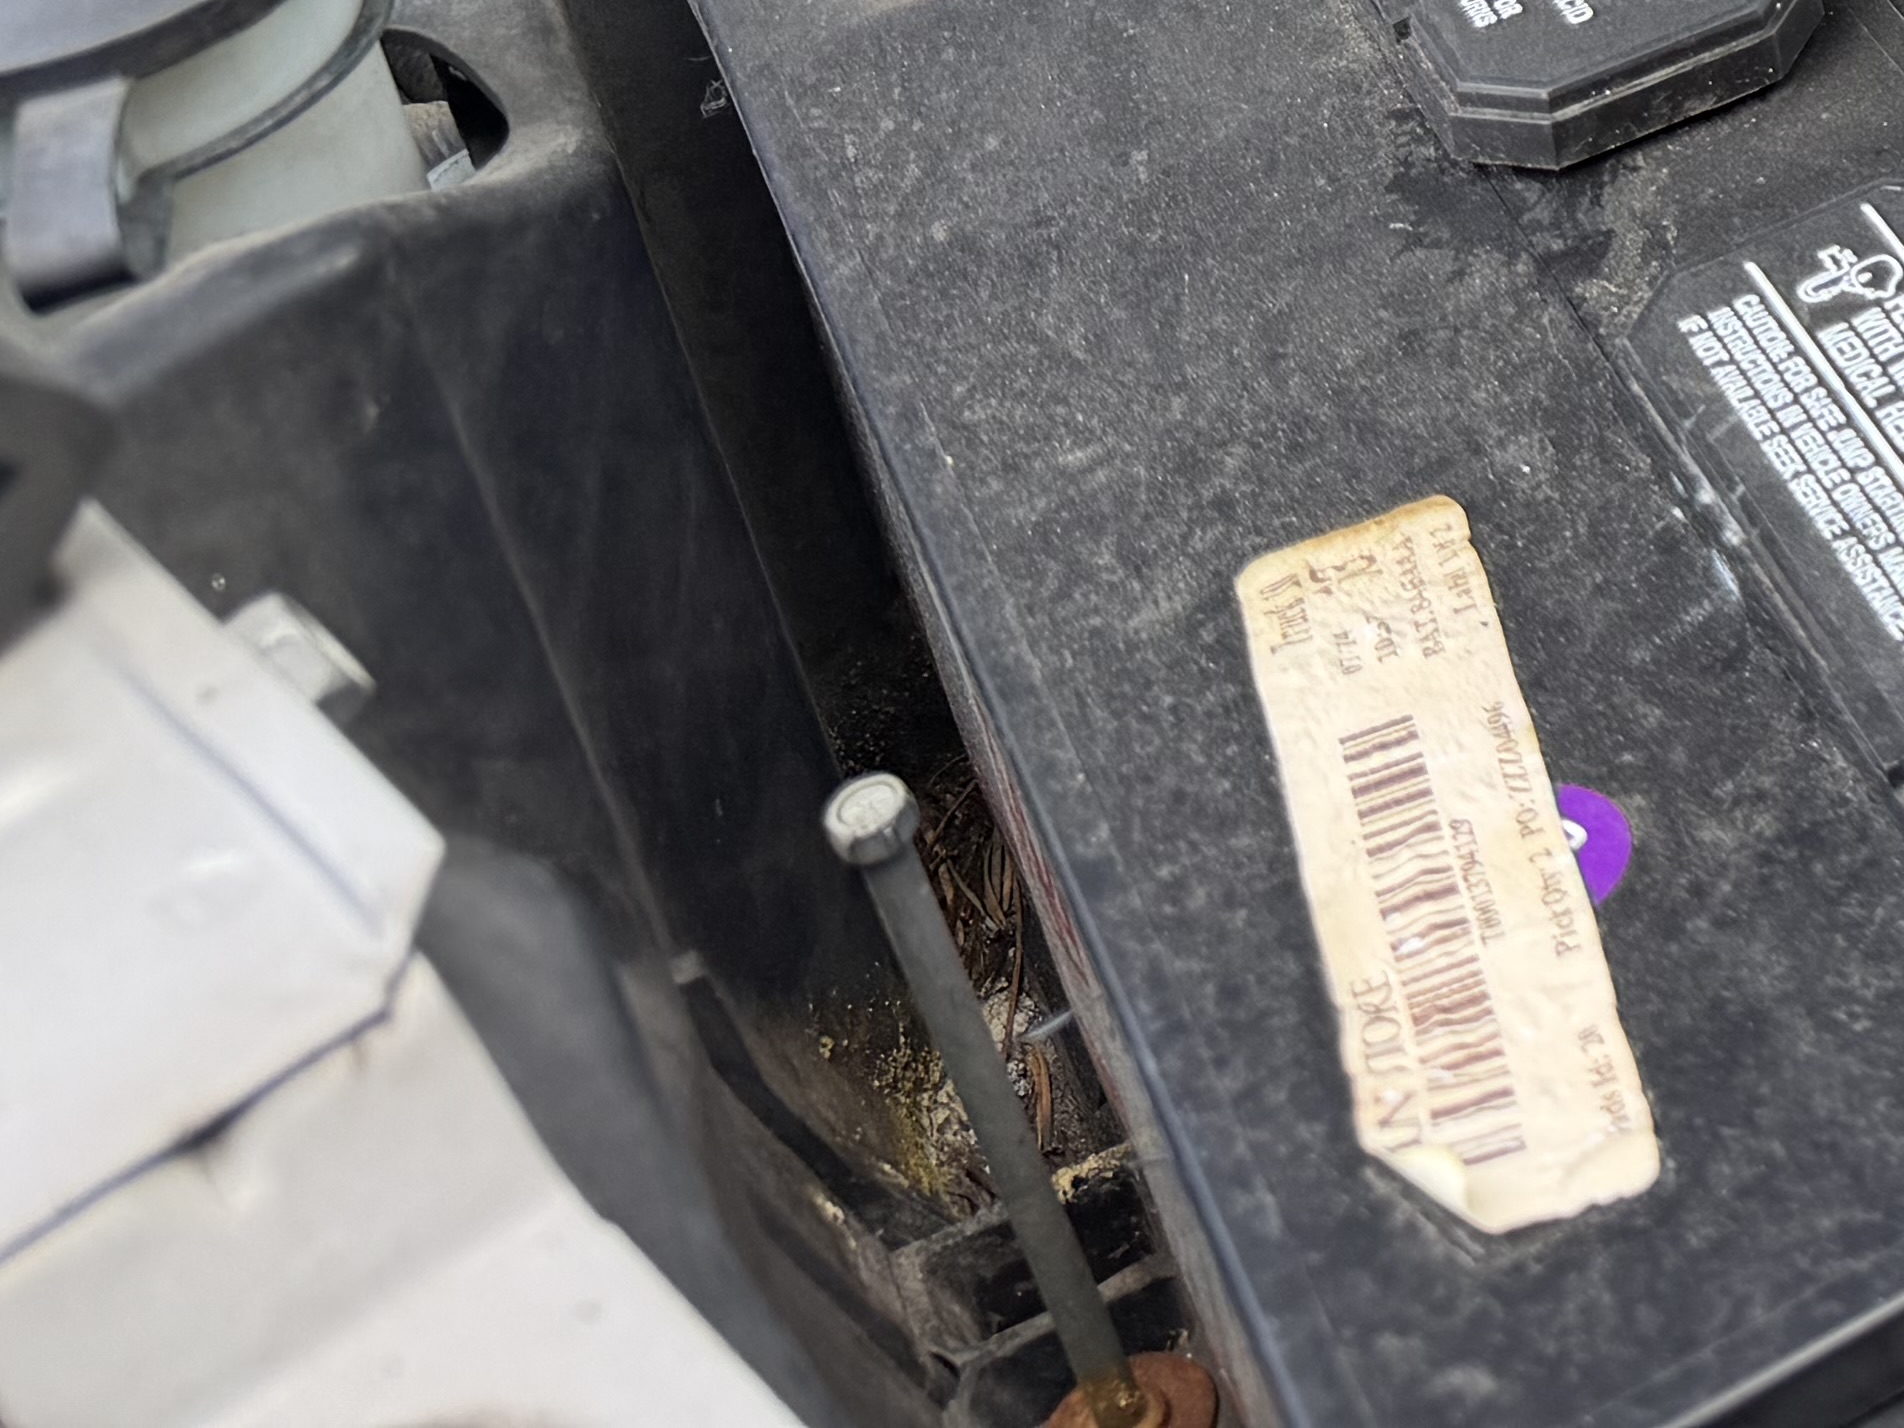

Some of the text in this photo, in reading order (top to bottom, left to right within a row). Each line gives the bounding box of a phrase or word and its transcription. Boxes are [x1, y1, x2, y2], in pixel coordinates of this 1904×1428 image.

[1678, 315, 1710, 334] IF
[1689, 331, 1731, 368] NOT
[1697, 307, 1805, 411] INSTRUCTIONS
[1816, 322, 1897, 410] MEDICAL
[1710, 365, 1788, 442] AVAILABLE
[1776, 405, 1809, 430] IN
[1778, 356, 1819, 395] FOR
[1800, 387, 1848, 433] SAFE
[1826, 428, 1877, 470] JUMP
[1760, 435, 1816, 482] SEEK
[1790, 422, 1861, 490] VEHICLE
[1787, 474, 1851, 542] SERVICE
[1261, 593, 1315, 655] Truck
[1541, 905, 1587, 958] Pick
[1343, 966, 1415, 1076] STORE
